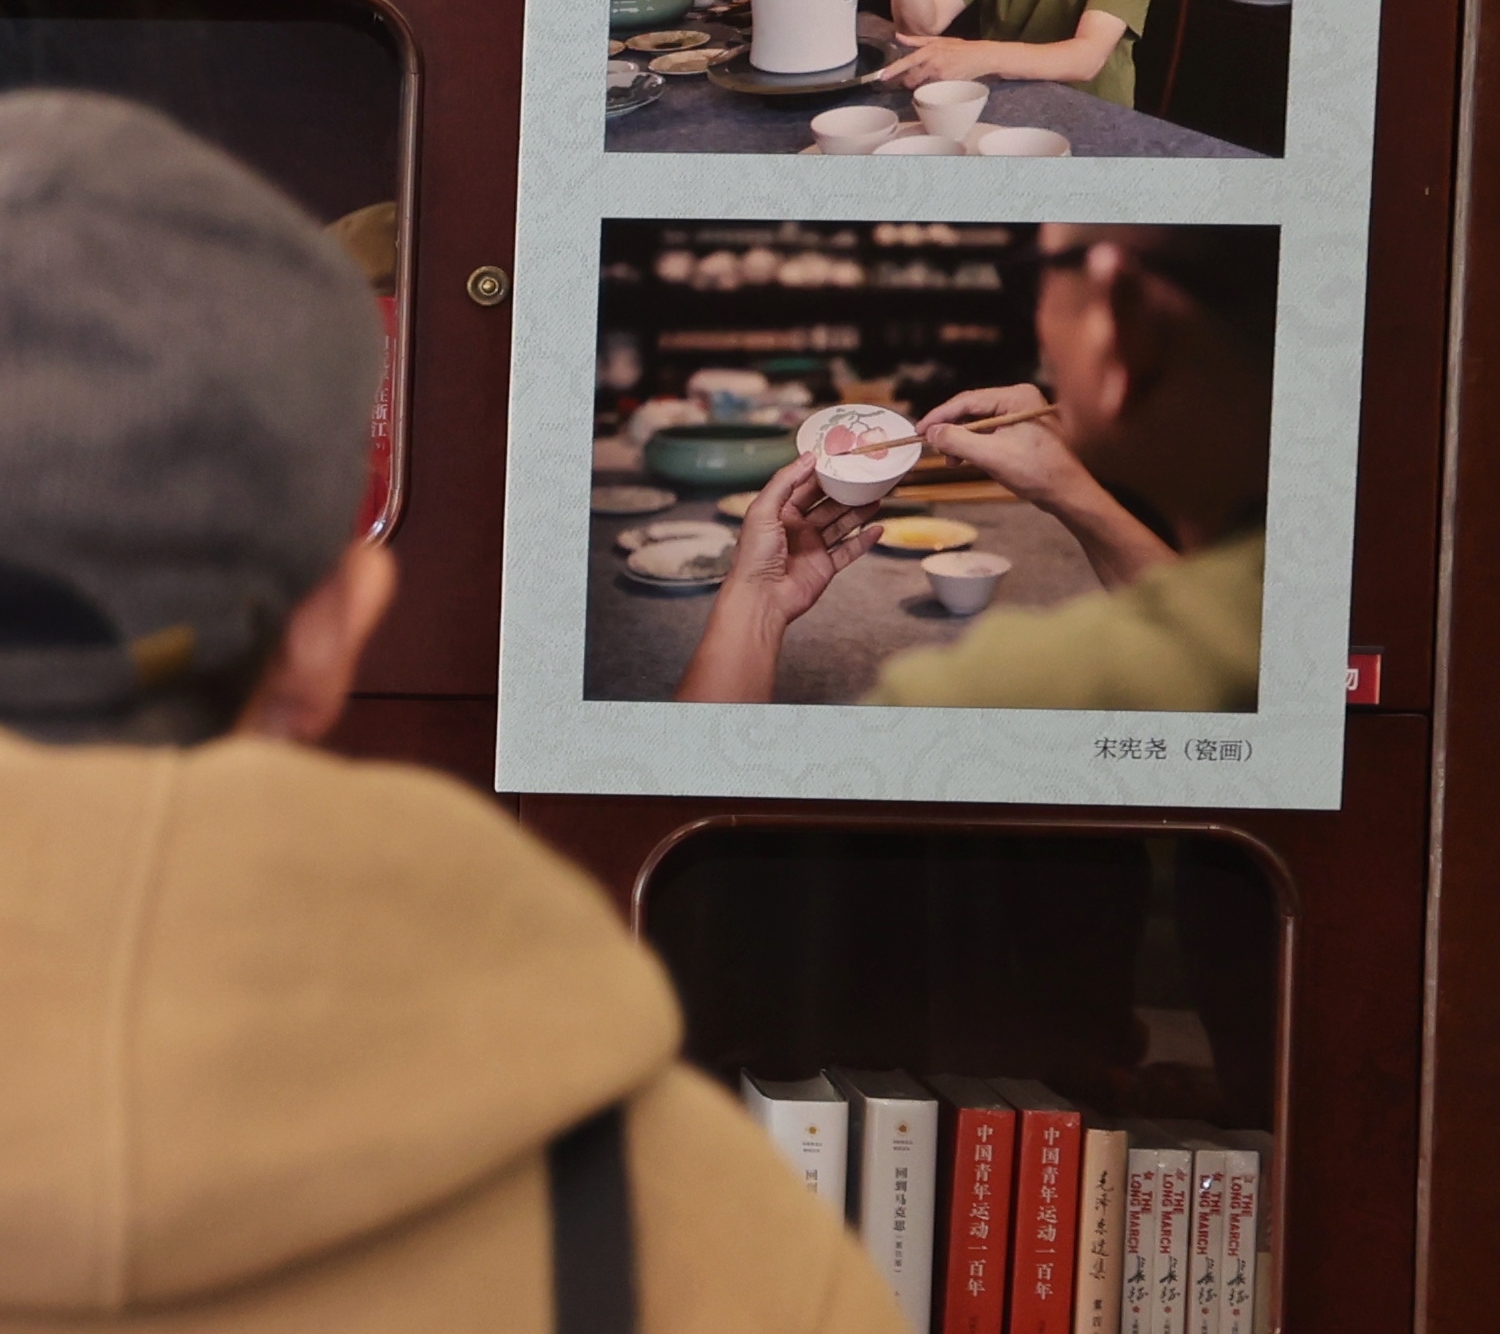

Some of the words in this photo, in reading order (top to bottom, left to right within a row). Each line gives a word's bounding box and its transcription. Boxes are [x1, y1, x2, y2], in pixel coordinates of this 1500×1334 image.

[1093, 737, 1256, 764] 宋宪尧（瓷画）
[1129, 1173, 1142, 1208] LONG
[1140, 1191, 1153, 1215] THE
[1161, 1173, 1175, 1209] LONG
[1173, 1191, 1185, 1215] THE
[1210, 1192, 1223, 1216] THE
[1229, 1175, 1243, 1210] LONG
[1241, 1193, 1253, 1218] THE
[966, 1123, 994, 1298] 中国青年运动一百年
[1033, 1126, 1062, 1301] 中国青年运动一百年
[1126, 1210, 1141, 1255] MARCH
[1159, 1210, 1173, 1255] MARCH
[1196, 1211, 1210, 1256] MARCH
[1227, 1211, 1241, 1257] MARCH
